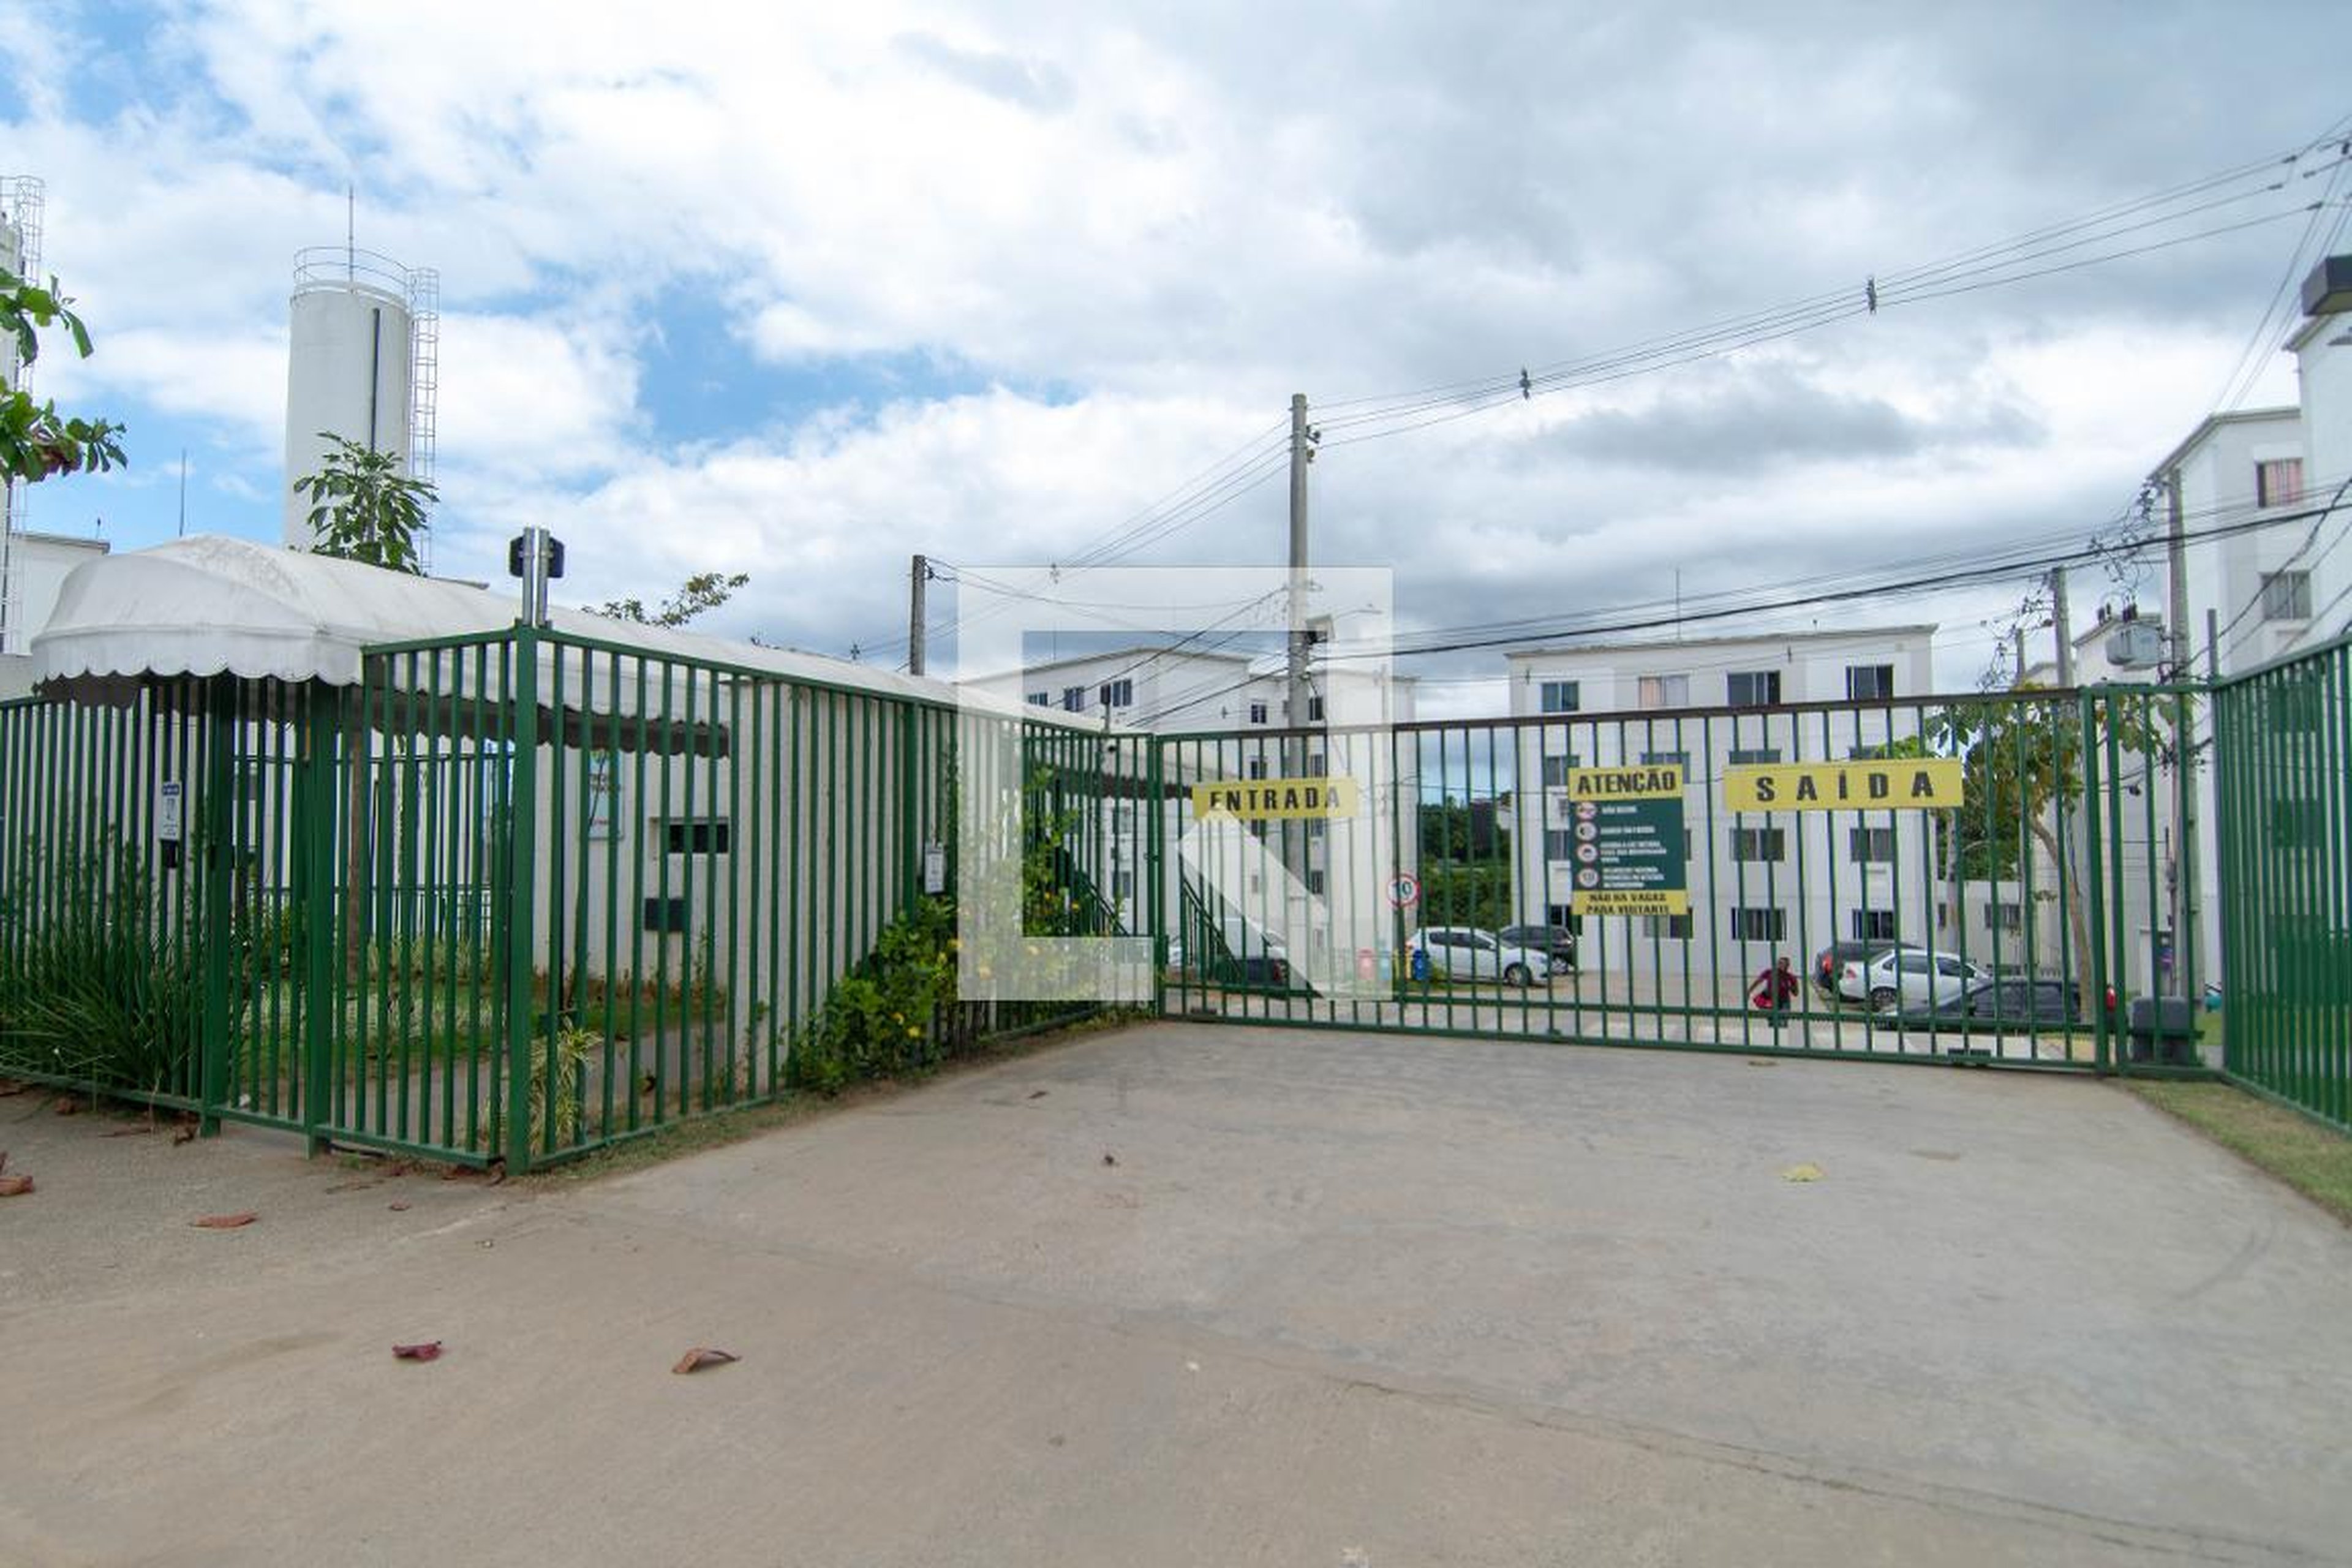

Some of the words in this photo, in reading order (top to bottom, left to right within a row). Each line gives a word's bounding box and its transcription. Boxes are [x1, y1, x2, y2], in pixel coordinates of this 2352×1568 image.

[1577, 767, 1676, 796] ATENÇÃO
[1755, 769, 1934, 802] SAÍDA
[1209, 786, 1340, 811] ENTRADA
